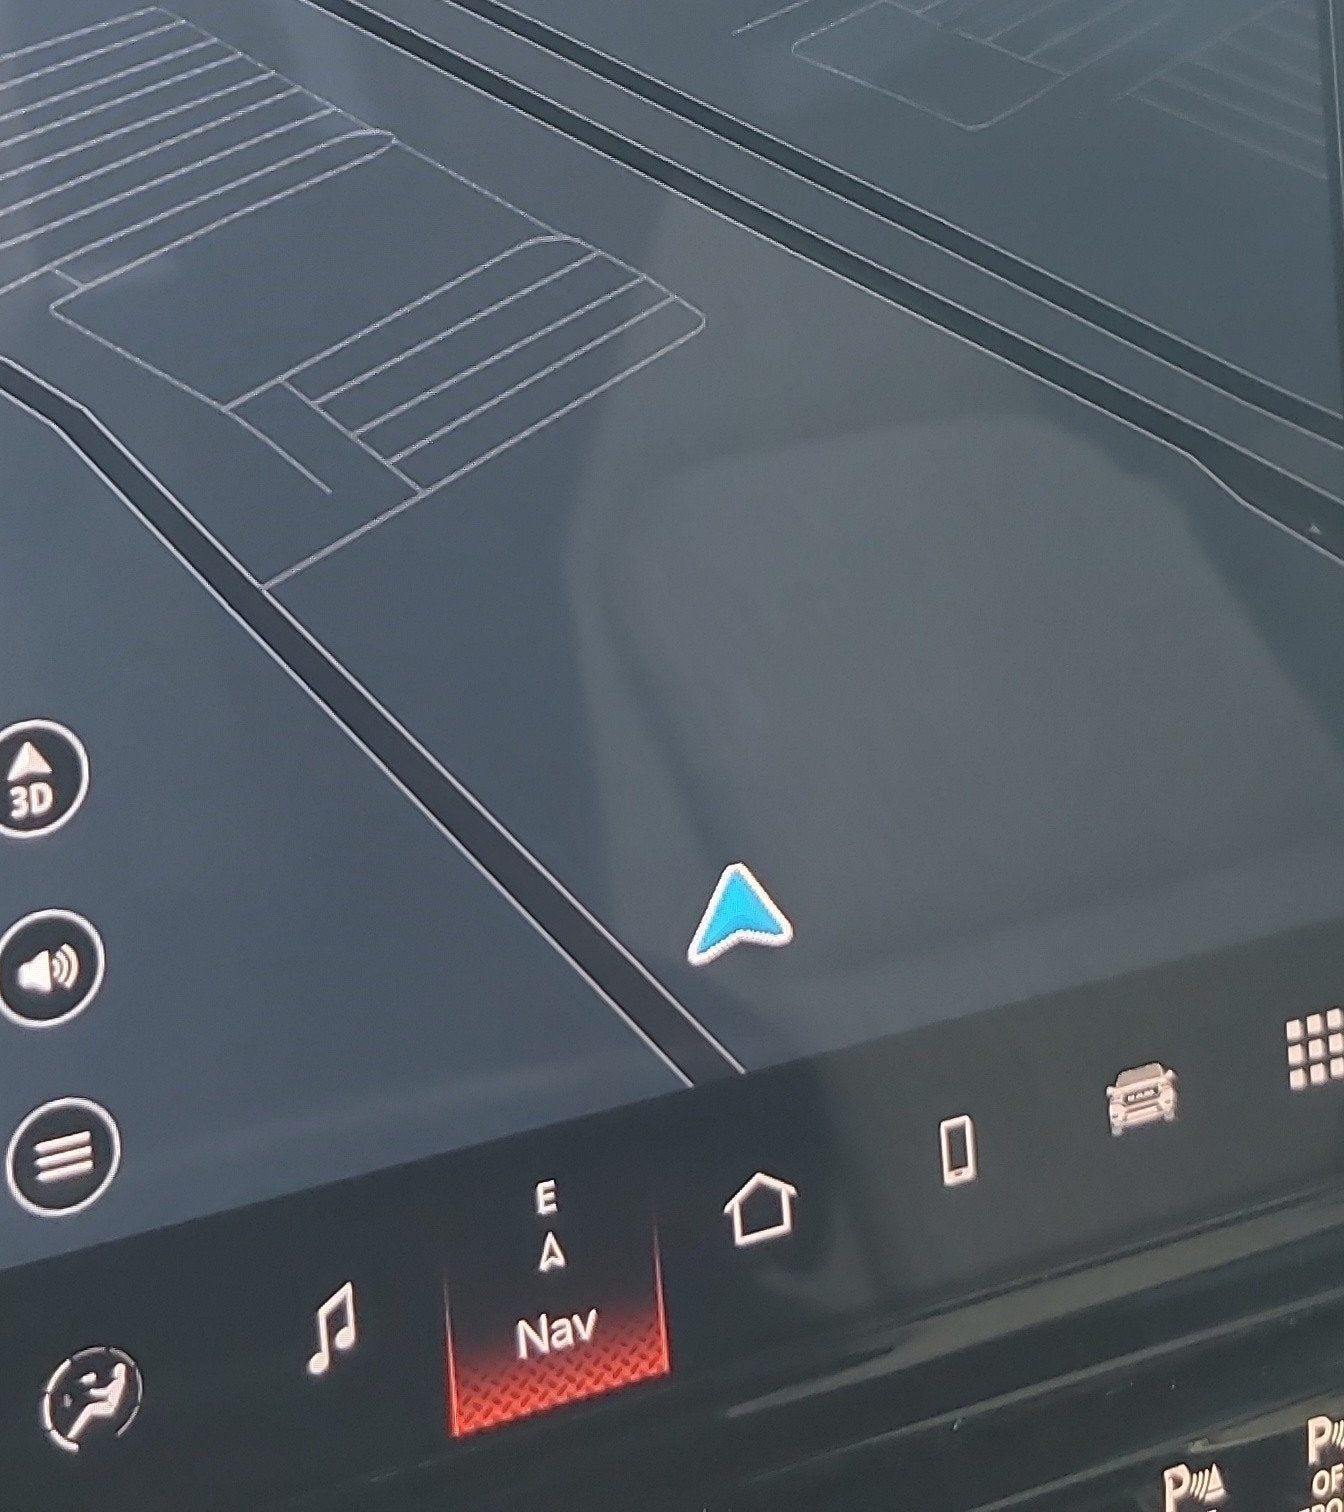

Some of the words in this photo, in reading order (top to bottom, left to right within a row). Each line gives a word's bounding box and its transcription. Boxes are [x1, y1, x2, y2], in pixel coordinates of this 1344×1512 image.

[9, 781, 54, 820] 3D
[535, 1179, 558, 1216] E
[516, 1307, 599, 1361] Nav
